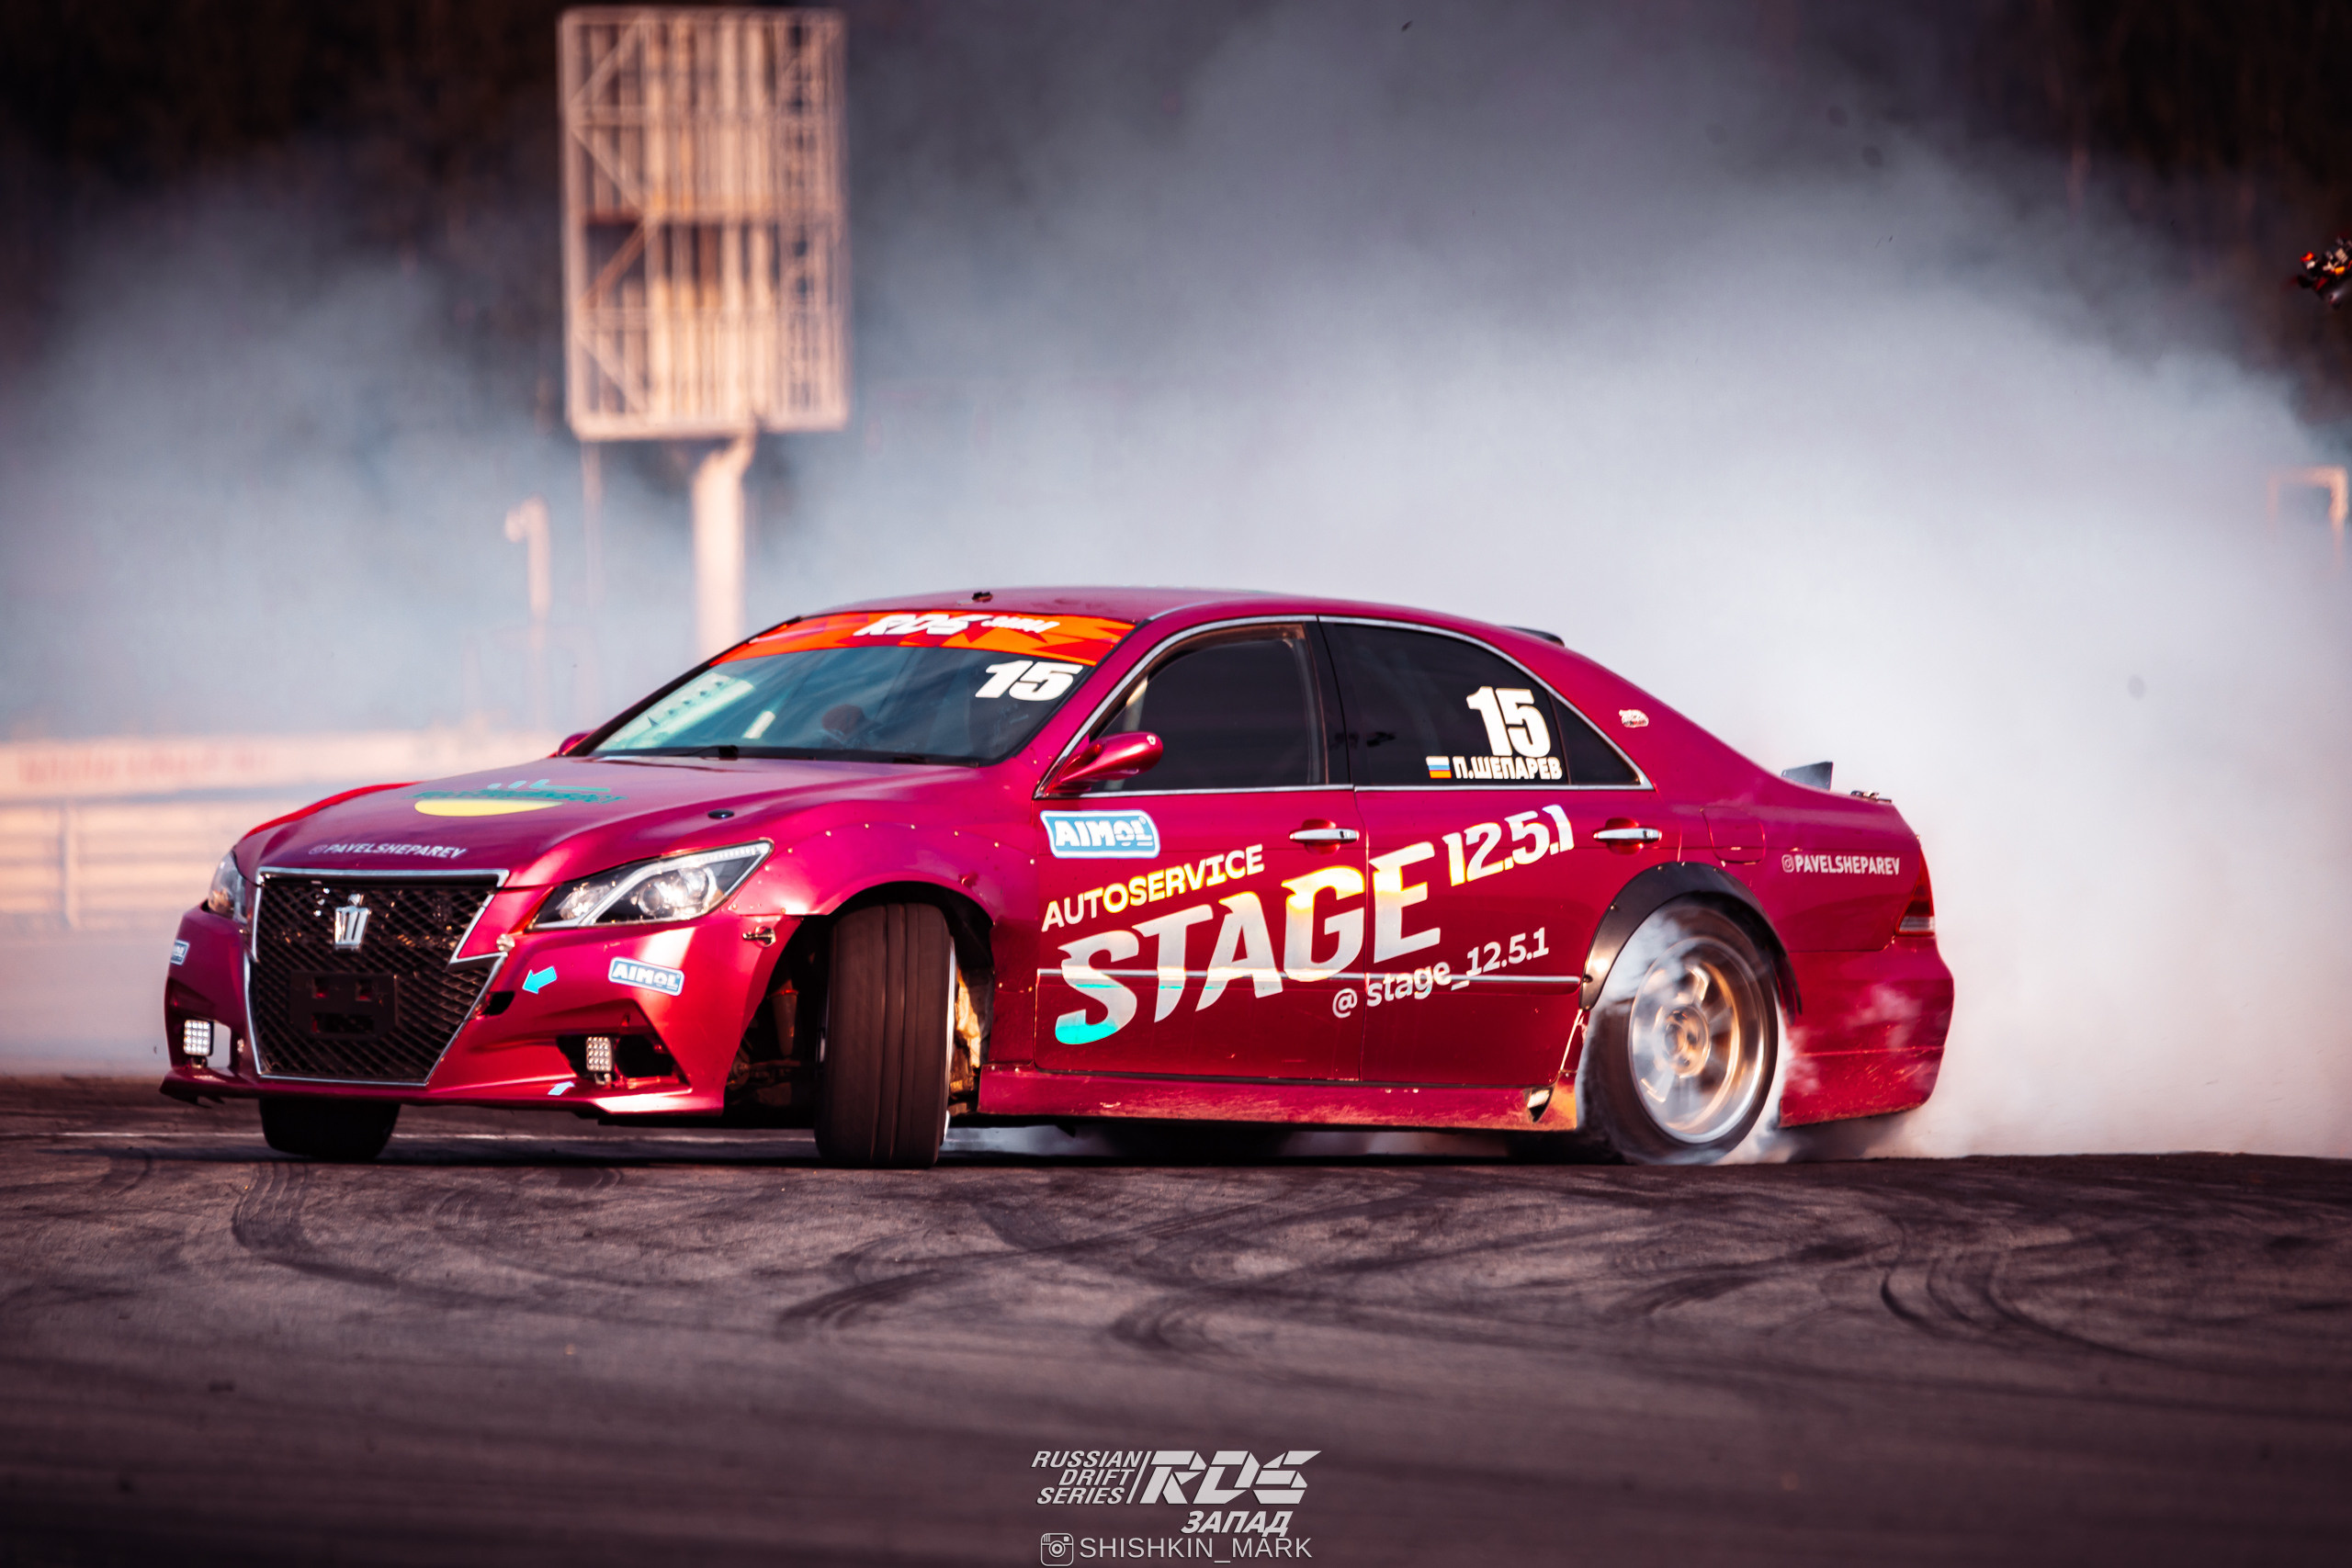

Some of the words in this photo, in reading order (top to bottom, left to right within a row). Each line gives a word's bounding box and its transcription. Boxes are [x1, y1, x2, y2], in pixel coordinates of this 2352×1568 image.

[853, 614, 993, 636] RDS
[975, 660, 1083, 701] 15
[1466, 686, 1551, 758] 15
[1054, 819, 1153, 847] AIMOL
[1041, 843, 1265, 932] AUTOSERVICE
[1055, 841, 1441, 1044] STAGE
[611, 963, 679, 990] AIMOL
